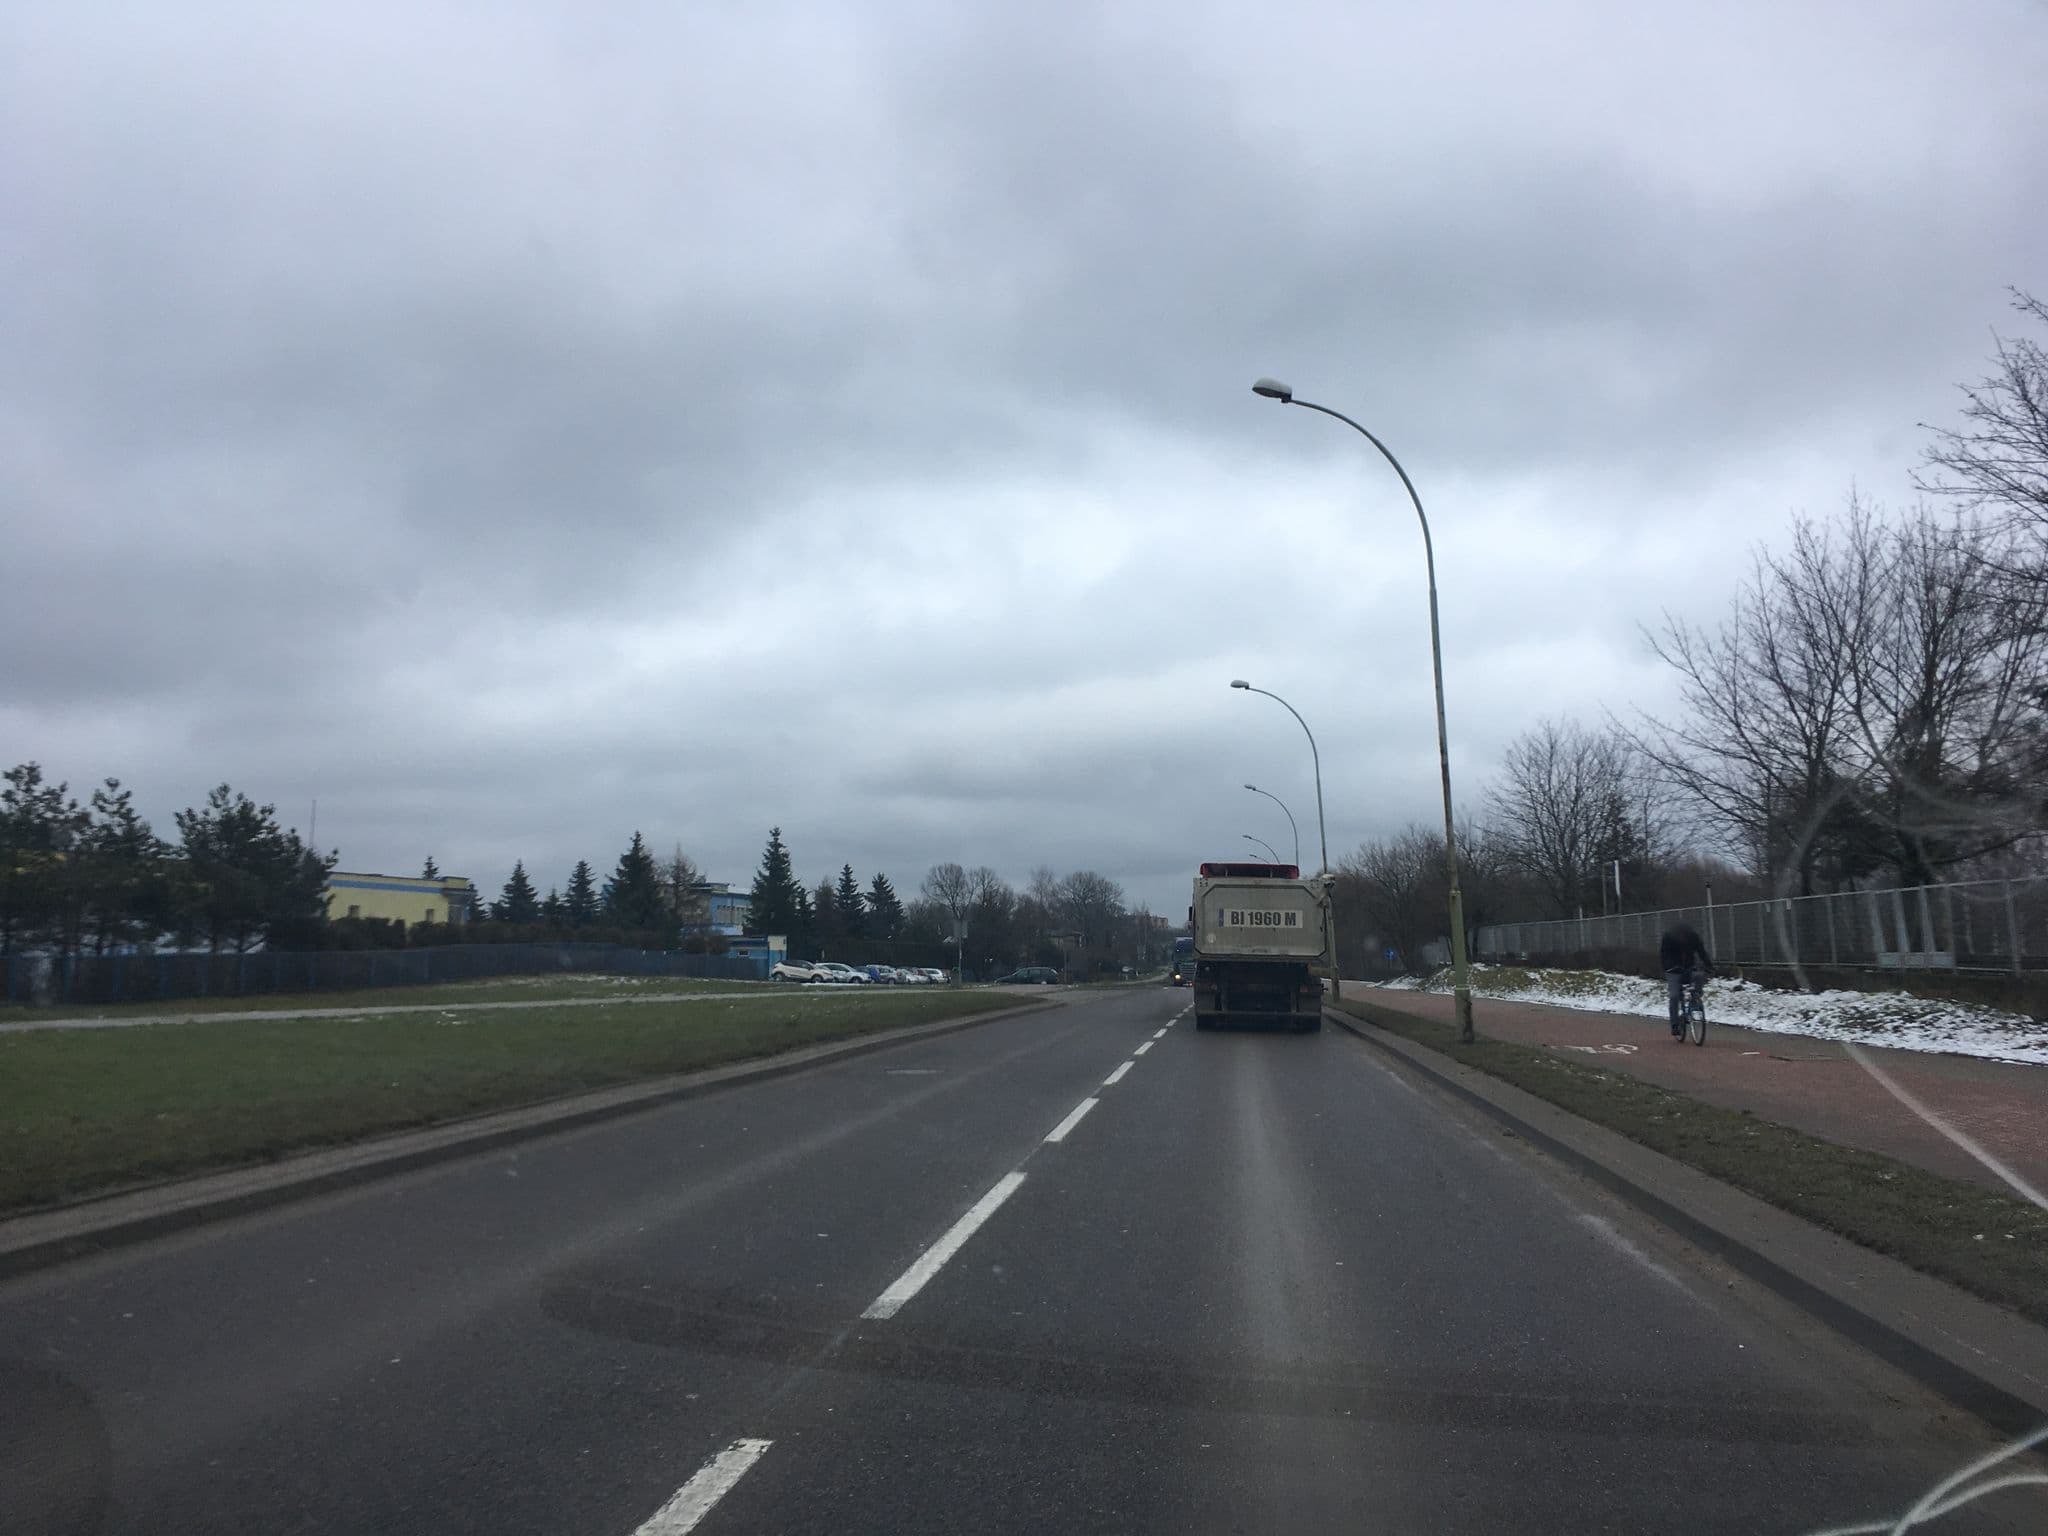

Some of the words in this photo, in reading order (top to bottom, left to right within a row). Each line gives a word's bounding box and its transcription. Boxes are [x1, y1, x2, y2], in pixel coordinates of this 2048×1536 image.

[1231, 911, 1244, 925] BI
[1247, 911, 1281, 926] 1960
[1284, 912, 1296, 926] M
